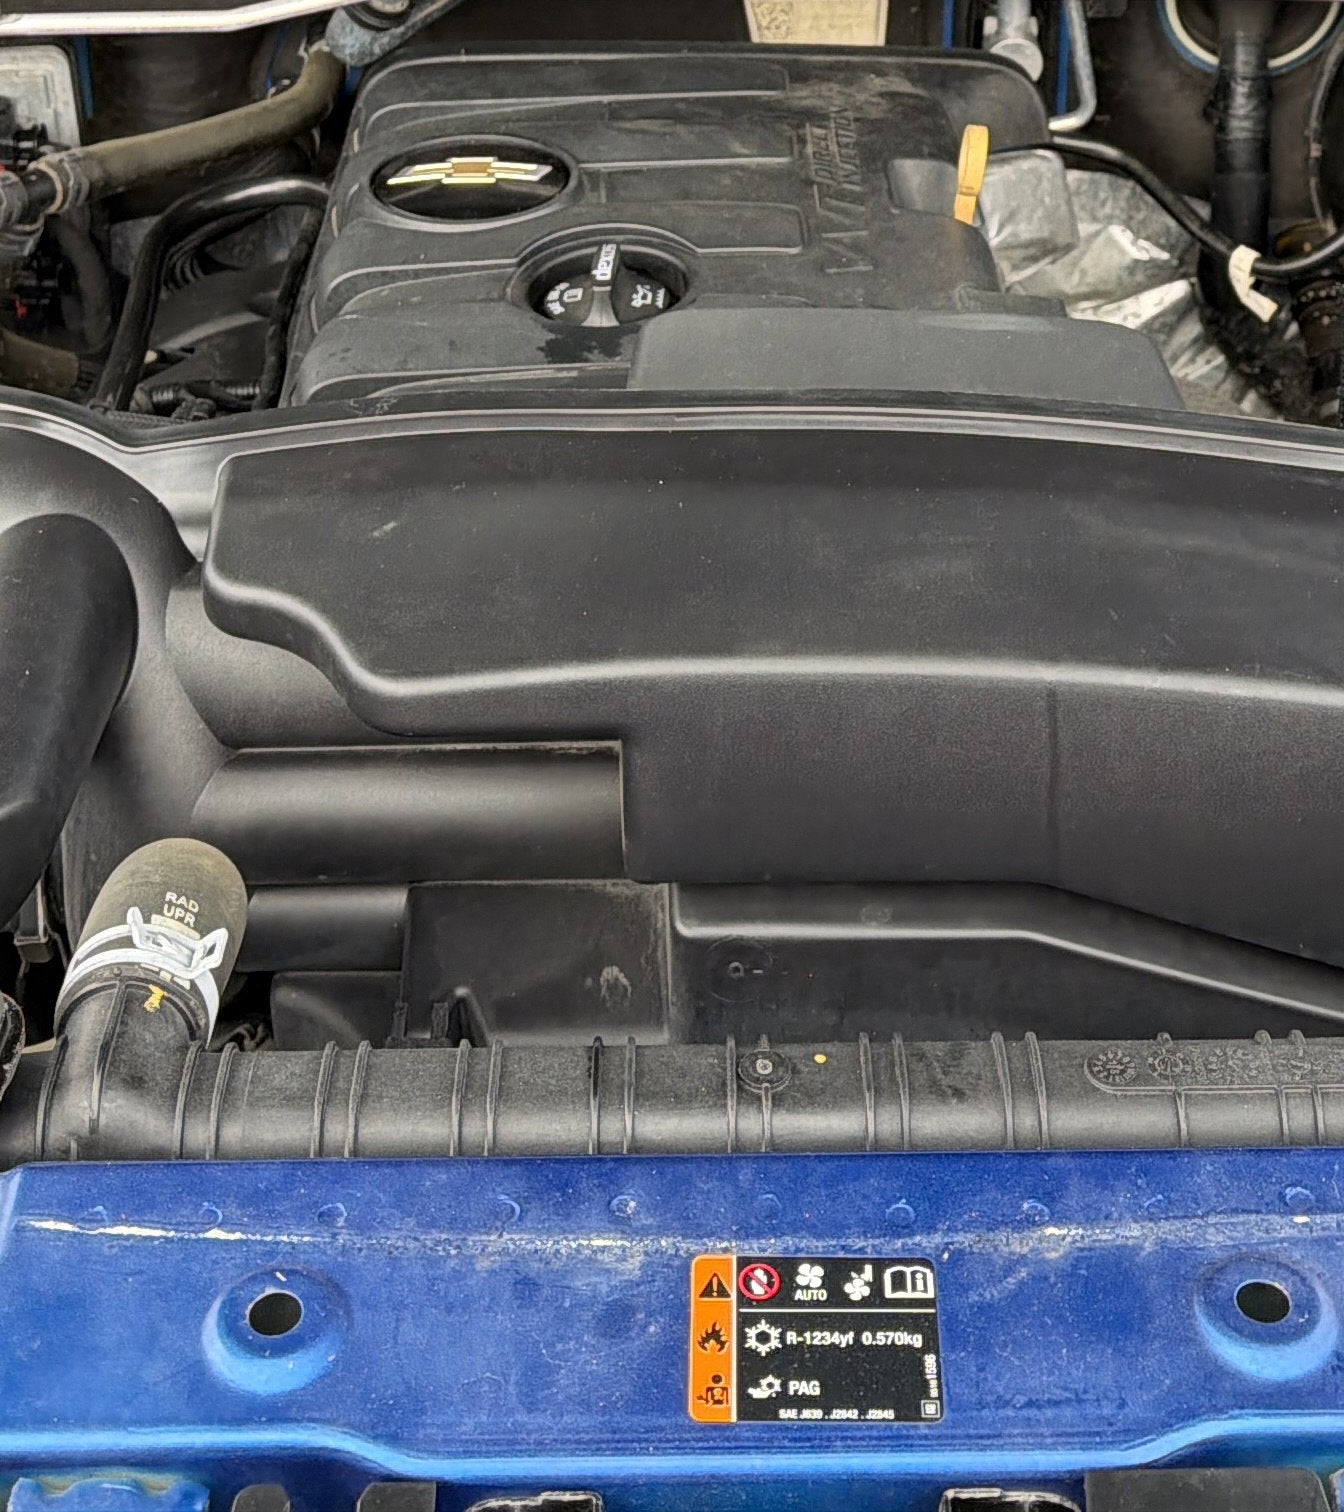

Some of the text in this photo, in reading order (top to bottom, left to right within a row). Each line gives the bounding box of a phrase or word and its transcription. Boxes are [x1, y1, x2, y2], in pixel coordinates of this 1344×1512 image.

[165, 891, 199, 914] RAD
[163, 904, 196, 928] UPR
[794, 1289, 827, 1301] AUTO
[786, 1331, 923, 1348] R-1234yf 0.570kg
[788, 1380, 821, 1396] PAG
[779, 1408, 798, 1420] SAE
